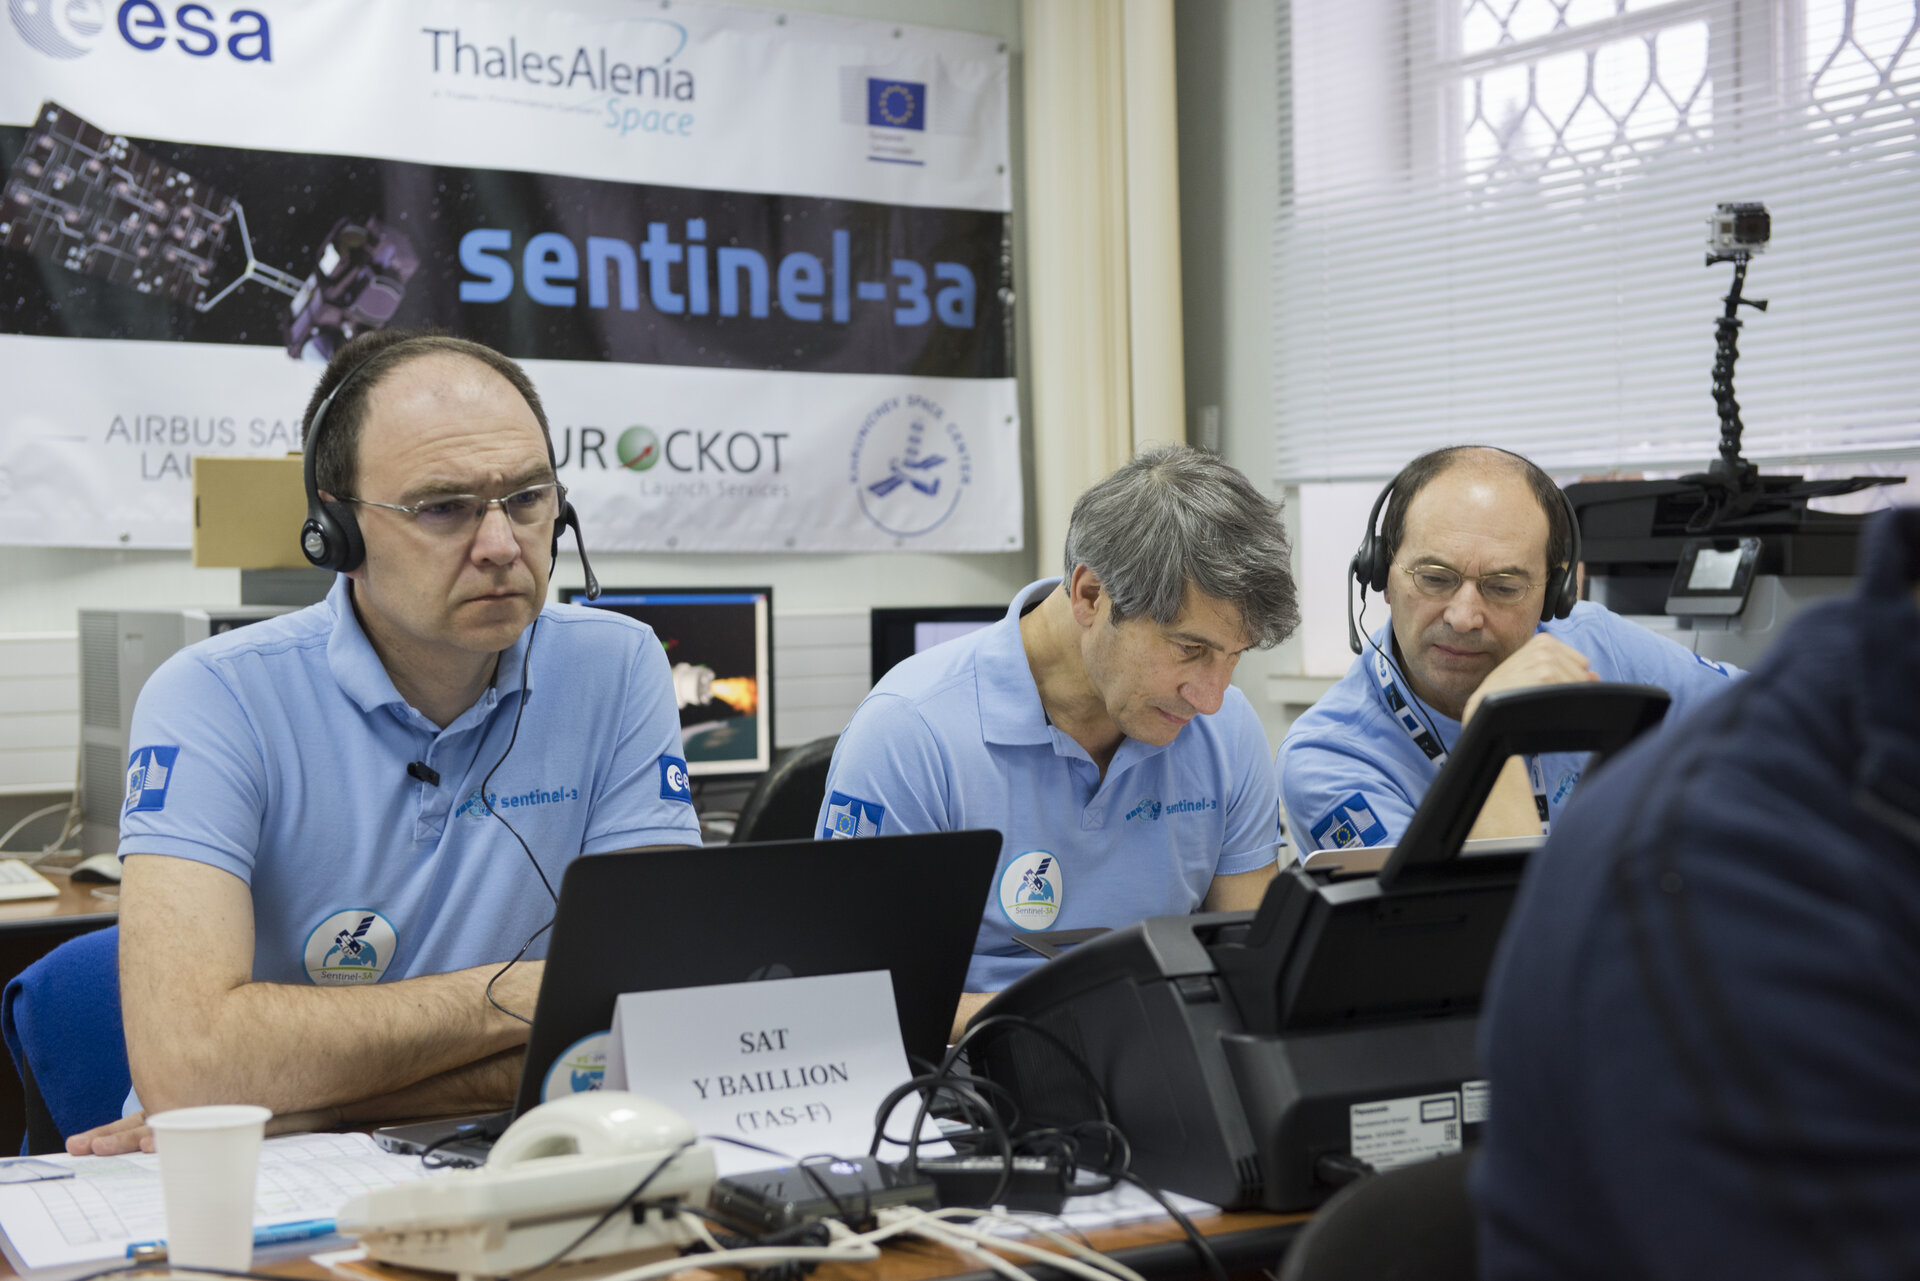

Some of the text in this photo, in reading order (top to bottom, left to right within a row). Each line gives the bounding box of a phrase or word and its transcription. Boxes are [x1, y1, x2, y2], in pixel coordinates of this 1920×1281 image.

[116, 0, 272, 62] esa
[604, 97, 695, 136] Space
[459, 218, 977, 329] sentinel-3a
[104, 414, 237, 447] AIRBUS
[640, 479, 791, 498] Launch Services
[500, 785, 578, 809] sentinel-3
[321, 970, 373, 981] Sentinel-3A
[739, 1028, 790, 1055] SAT
[692, 1062, 850, 1100] Y BAILLION
[736, 1102, 832, 1134] (TAS-F)
